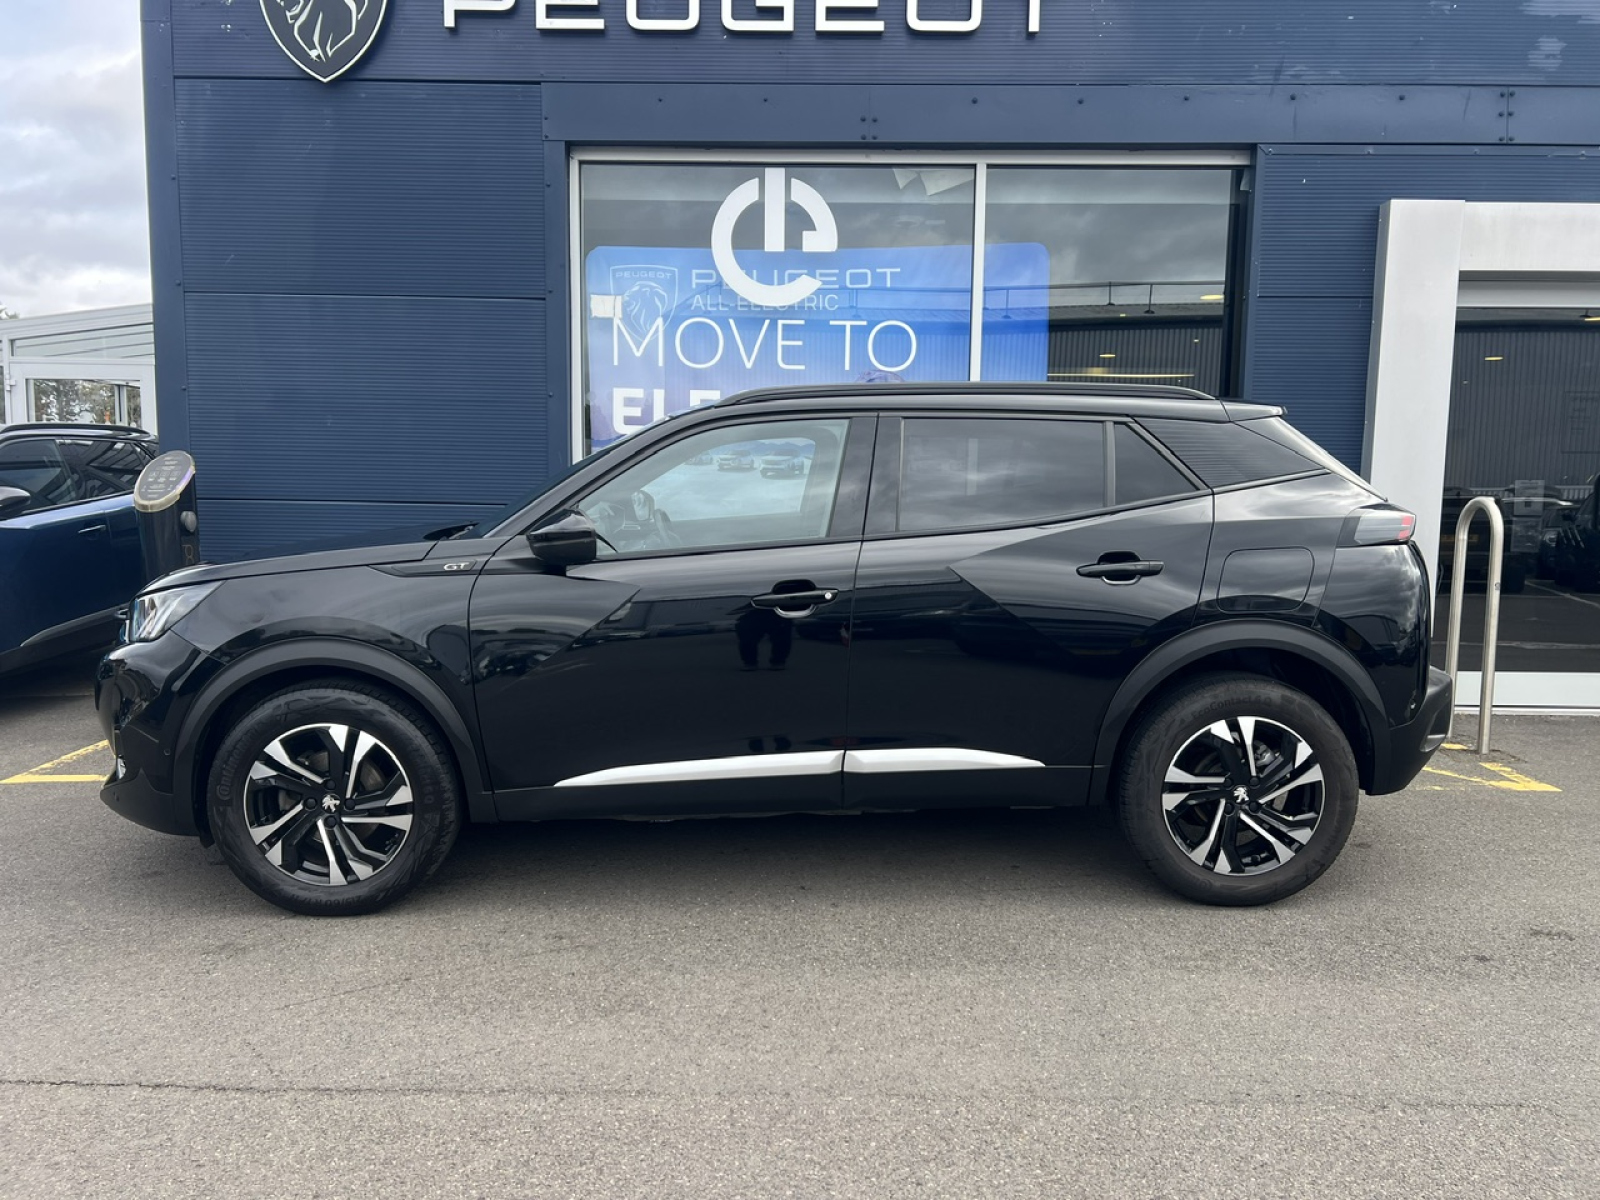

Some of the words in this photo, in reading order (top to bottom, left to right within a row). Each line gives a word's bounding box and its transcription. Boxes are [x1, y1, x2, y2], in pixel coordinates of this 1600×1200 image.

[615, 270, 673, 279] PEUGEOT
[613, 317, 805, 370] MOVE
[829, 319, 917, 372] TO
[443, 562, 470, 571] GT
